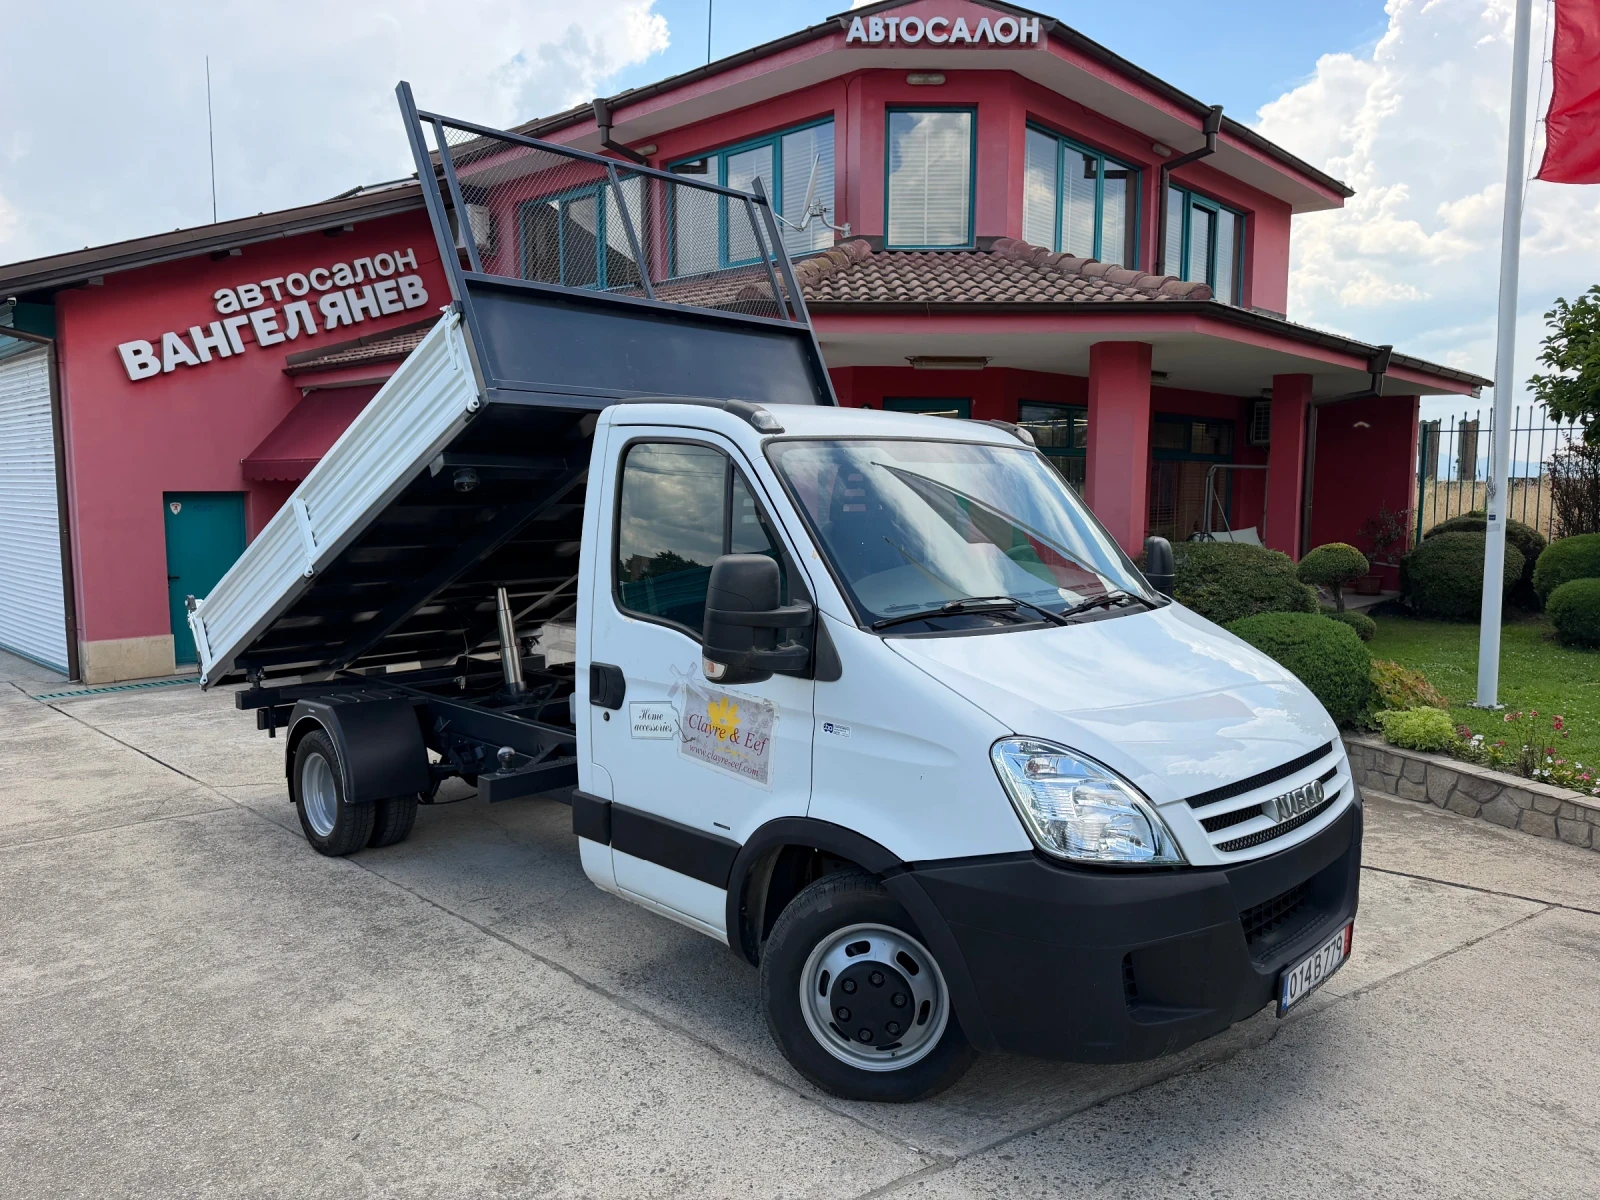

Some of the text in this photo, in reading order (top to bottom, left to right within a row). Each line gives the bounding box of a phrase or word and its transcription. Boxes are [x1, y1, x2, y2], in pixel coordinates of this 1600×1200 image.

[845, 16, 1041, 45] АВТОСАЛОН
[213, 247, 419, 315] автосалон
[116, 274, 430, 382] ВАНГЕЛ ЯНЕВ
[633, 721, 673, 733] accessories
[638, 708, 664, 721] Home
[688, 713, 769, 757] Clayre & Eef
[689, 743, 760, 777] www.clayre-eef.com
[1272, 780, 1324, 822] IVECO
